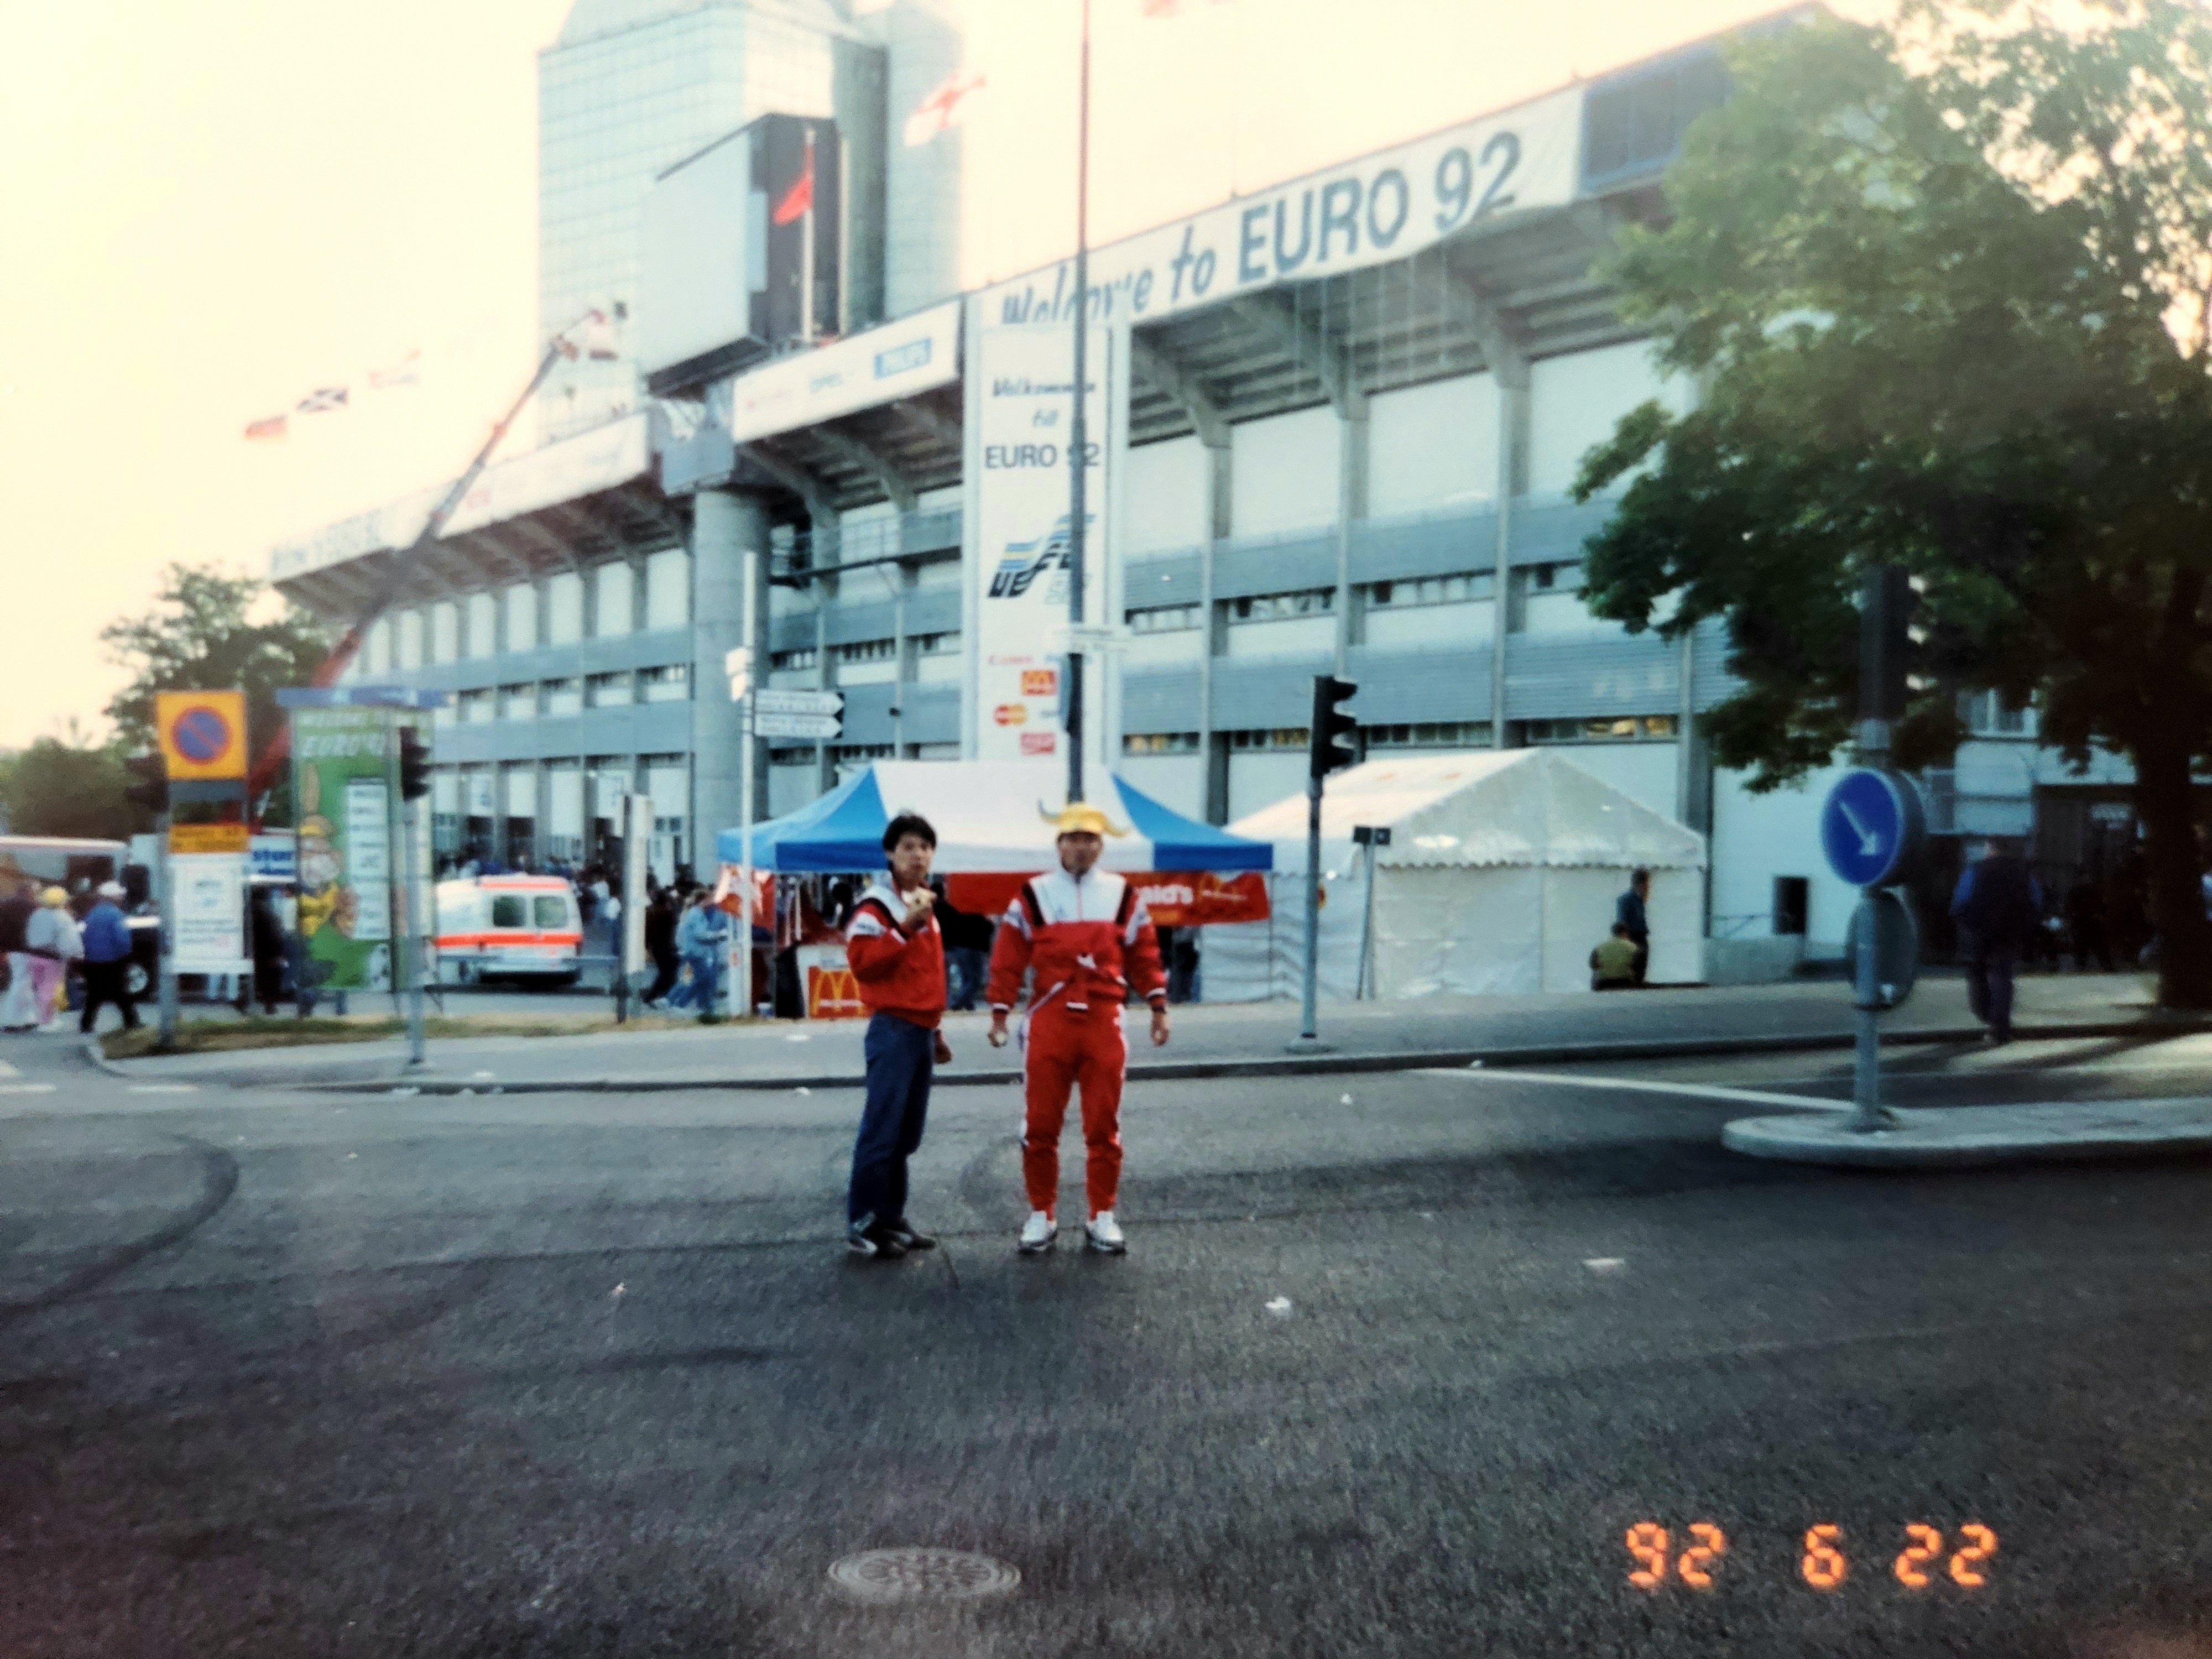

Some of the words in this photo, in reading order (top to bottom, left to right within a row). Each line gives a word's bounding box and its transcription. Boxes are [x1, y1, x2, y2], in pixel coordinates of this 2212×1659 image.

[1171, 224, 1217, 303] to
[1238, 167, 1410, 283] EURO
[1434, 131, 1522, 232] 92
[986, 444, 1057, 469] EURO
